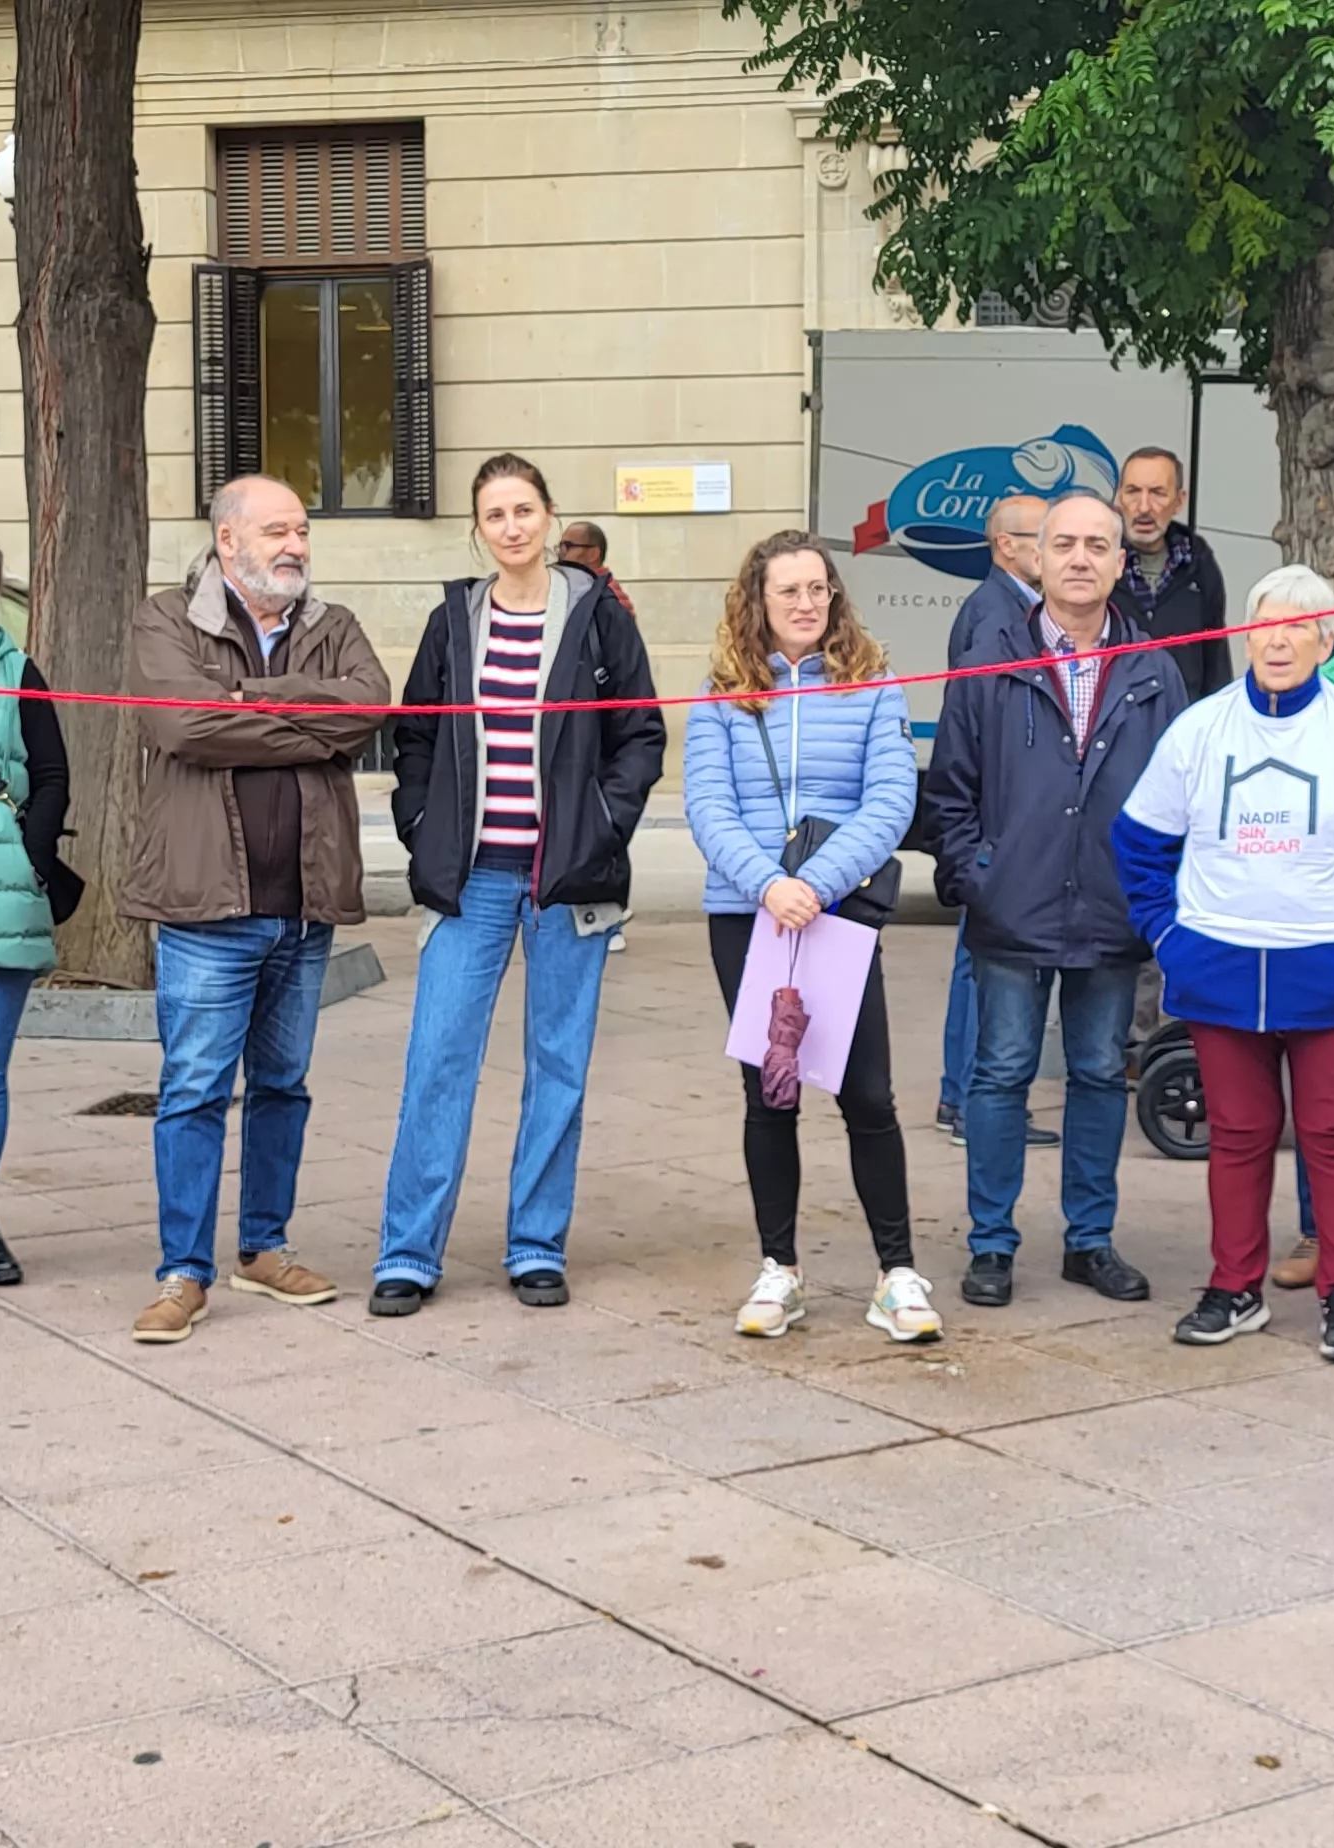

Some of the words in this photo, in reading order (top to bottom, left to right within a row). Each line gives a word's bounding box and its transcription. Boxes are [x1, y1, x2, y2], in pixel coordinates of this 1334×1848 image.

[944, 463, 984, 491] La
[1238, 811, 1291, 825] NADIE
[1238, 827, 1267, 840] SIN
[1236, 839, 1301, 855] HOGAR
